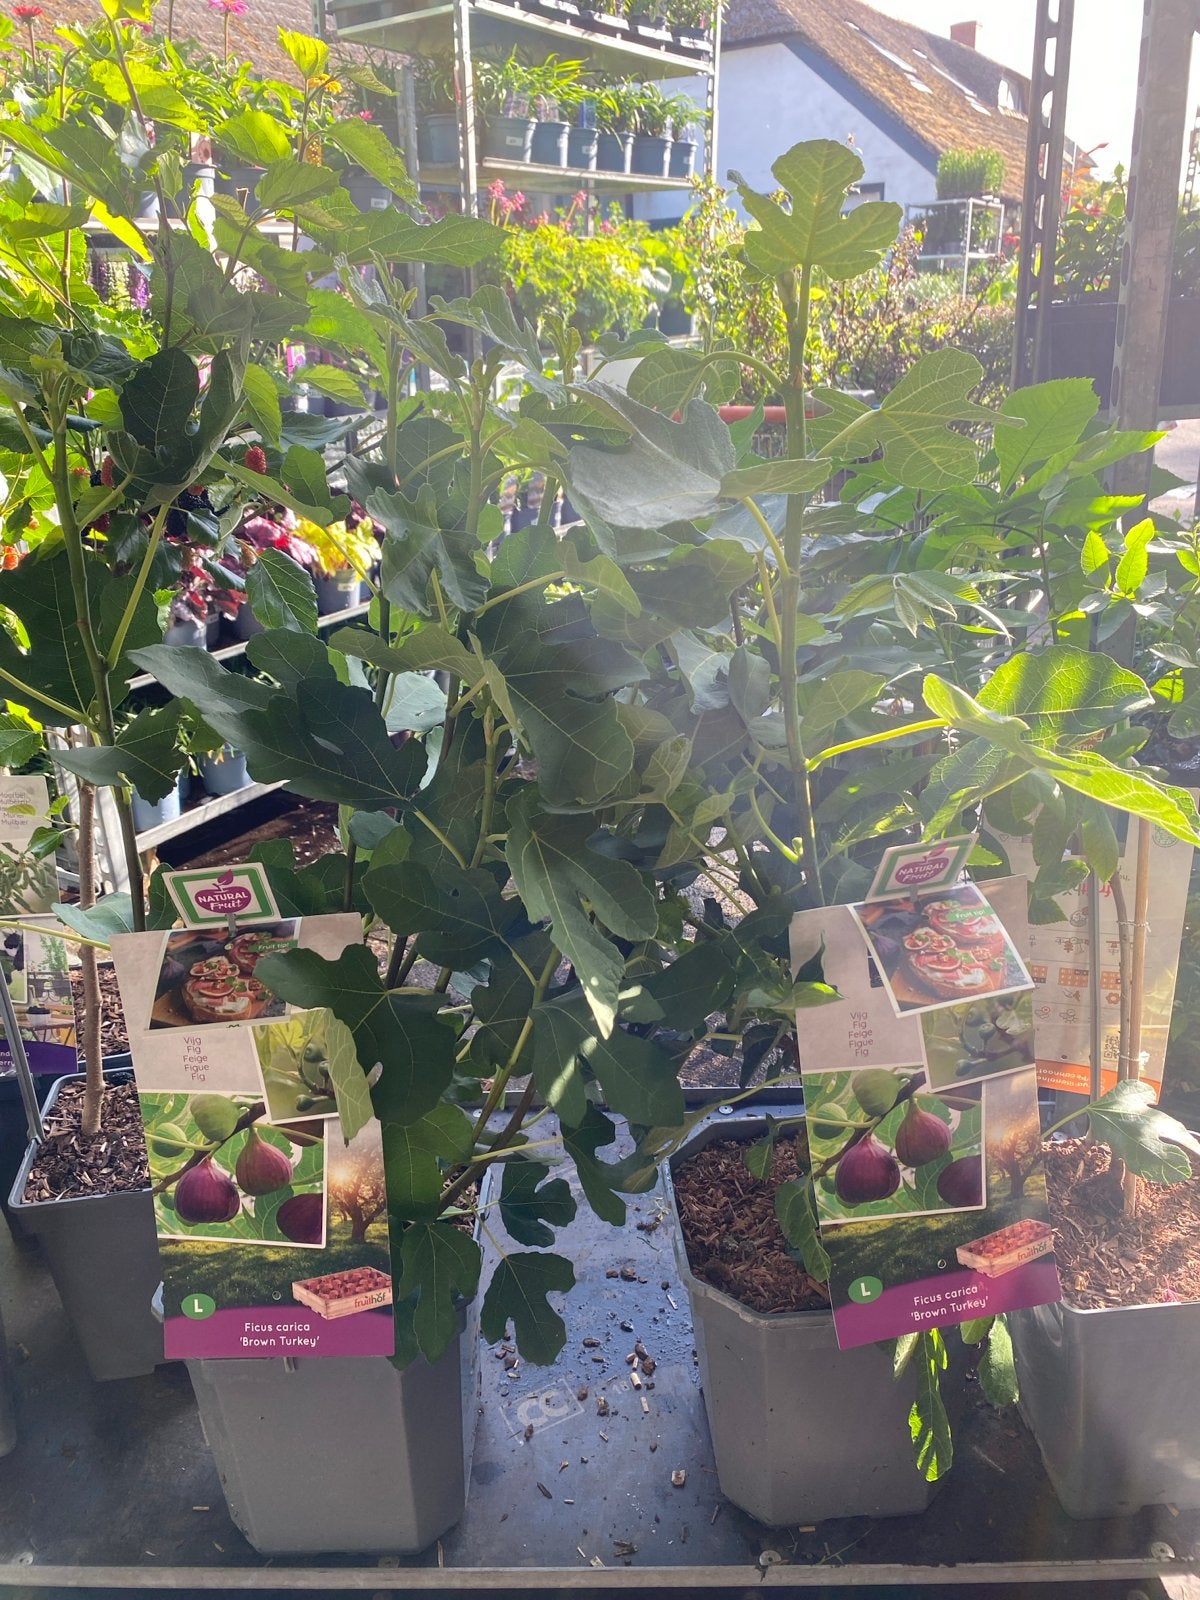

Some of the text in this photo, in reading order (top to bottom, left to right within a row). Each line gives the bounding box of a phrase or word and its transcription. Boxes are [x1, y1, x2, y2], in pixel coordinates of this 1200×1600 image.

[898, 862, 945, 876] NATURAL
[902, 870, 934, 882] Fruit
[197, 891, 249, 904] NATURAL
[210, 899, 243, 911] Fruit
[850, 1011, 868, 1021] Vijg
[852, 1021, 867, 1029] Fig
[848, 1029, 873, 1039] Feige
[183, 1036, 202, 1046] Vijg
[849, 1039, 874, 1050] Figue
[187, 1045, 202, 1055] Fig
[855, 1048, 869, 1057] Fig
[183, 1055, 208, 1064] Feige
[184, 1063, 210, 1074] Figue
[191, 1072, 206, 1081] Fig
[860, 1282, 871, 1297] L
[913, 1286, 978, 1307] Ficus carica
[194, 1299, 203, 1313] L
[911, 1296, 989, 1321] 'Brown Turkey'
[244, 1322, 310, 1333] Ficus carica
[239, 1335, 320, 1349] 'Brown Turkey'
